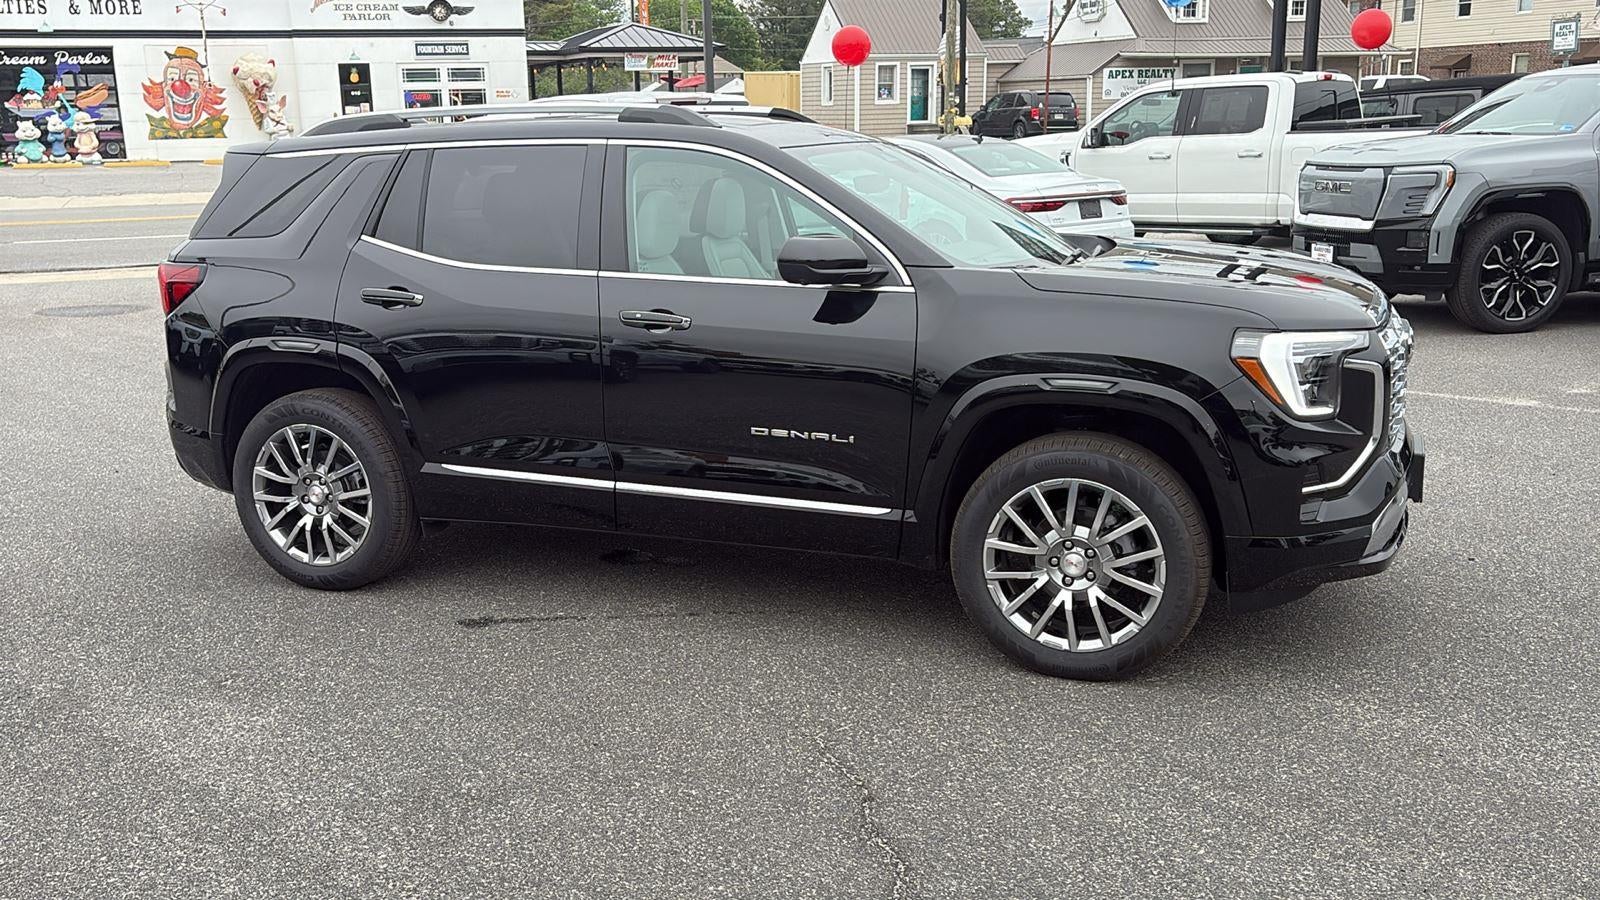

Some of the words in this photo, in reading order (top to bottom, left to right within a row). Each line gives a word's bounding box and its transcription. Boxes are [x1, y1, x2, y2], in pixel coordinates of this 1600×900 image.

[0, 0, 47, 14] TIES
[69, 0, 81, 15] &
[90, 0, 142, 15] MORE
[334, 3, 353, 11] ICE
[356, 3, 399, 11] CREAM
[343, 13, 391, 21] PARLOR
[417, 45, 444, 54] FOUNTAIN
[445, 45, 468, 54] SERVICE
[54, 51, 110, 65] Parlor
[1107, 69, 1134, 79] APEX
[1137, 69, 1176, 79] REALTY
[1314, 180, 1352, 194] GMC
[750, 427, 855, 444] DENALI
